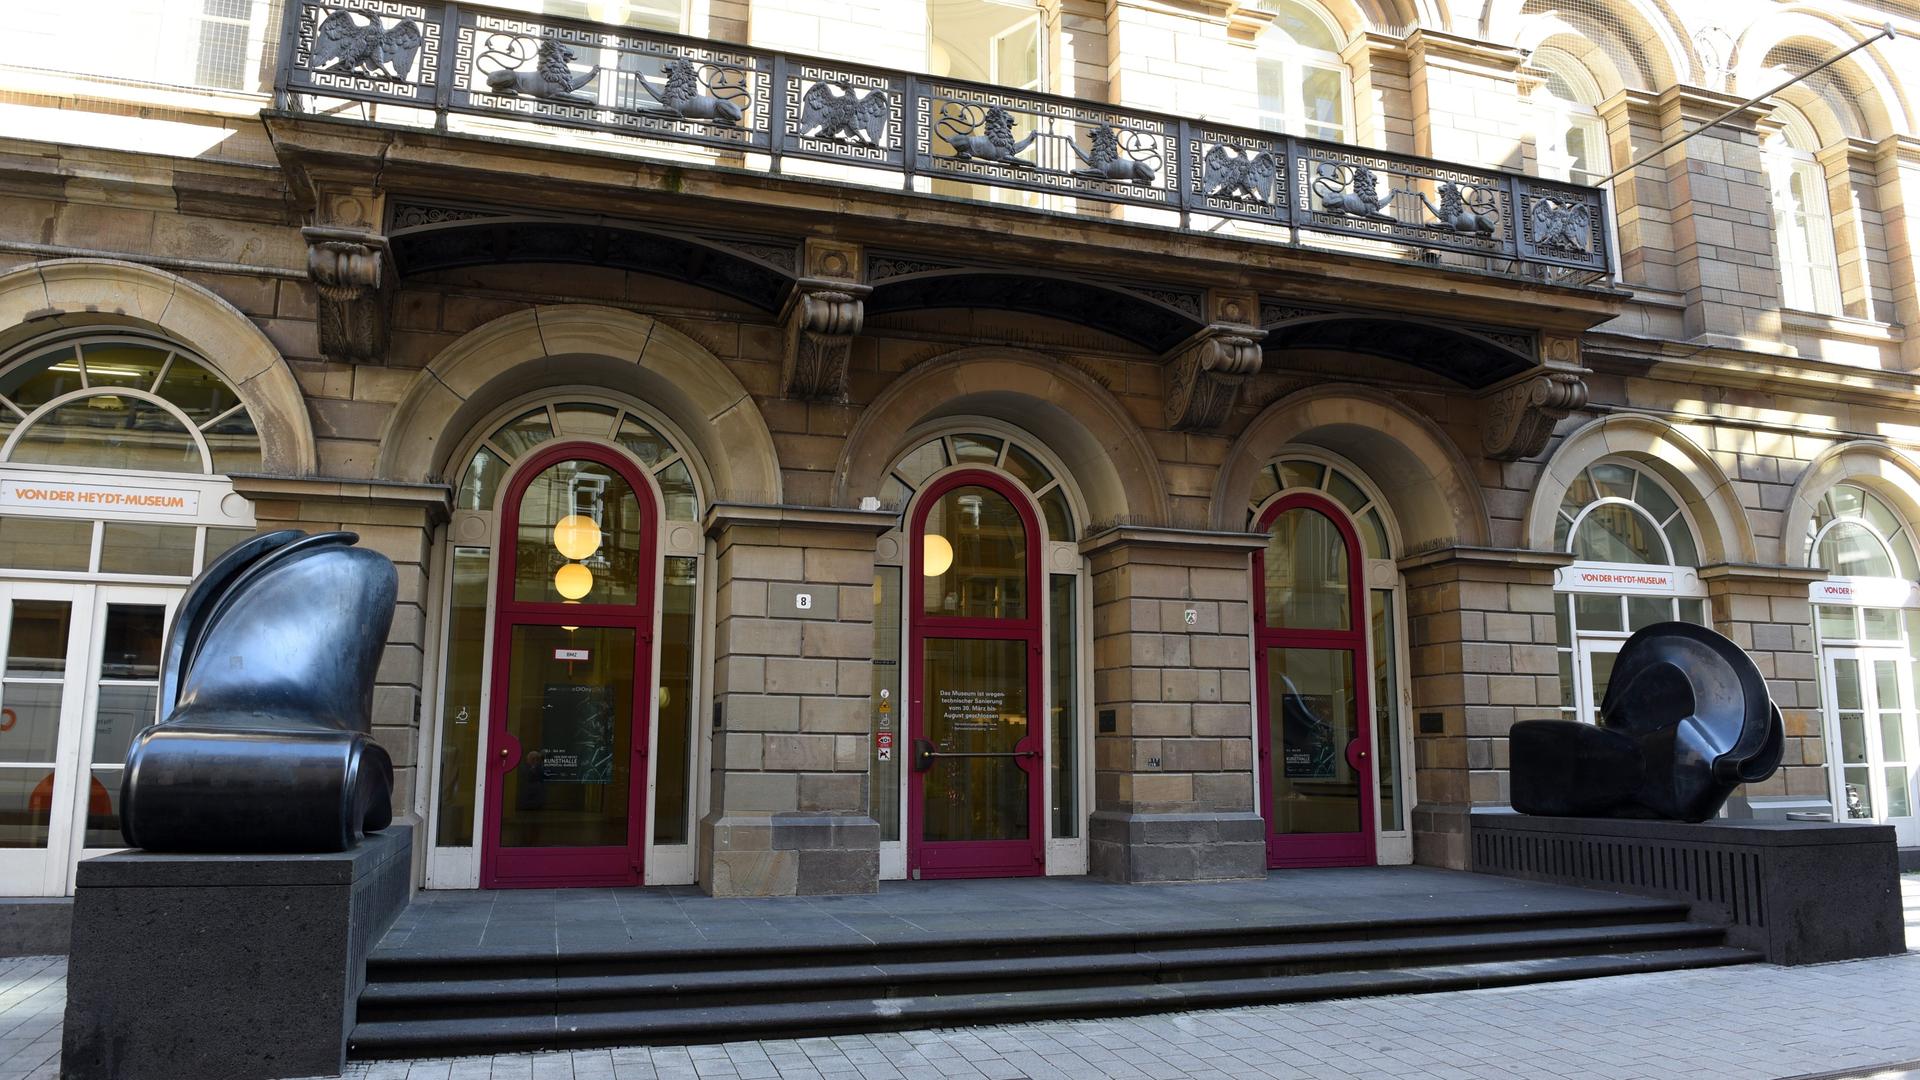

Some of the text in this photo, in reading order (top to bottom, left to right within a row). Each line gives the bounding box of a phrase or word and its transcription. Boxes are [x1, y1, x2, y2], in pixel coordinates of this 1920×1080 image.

[16, 488, 184, 508] VON DER HEYDT-MUSEUM
[1582, 574, 1667, 584] VON DER HEYDT-MUSEUM
[800, 596, 806, 606] 8
